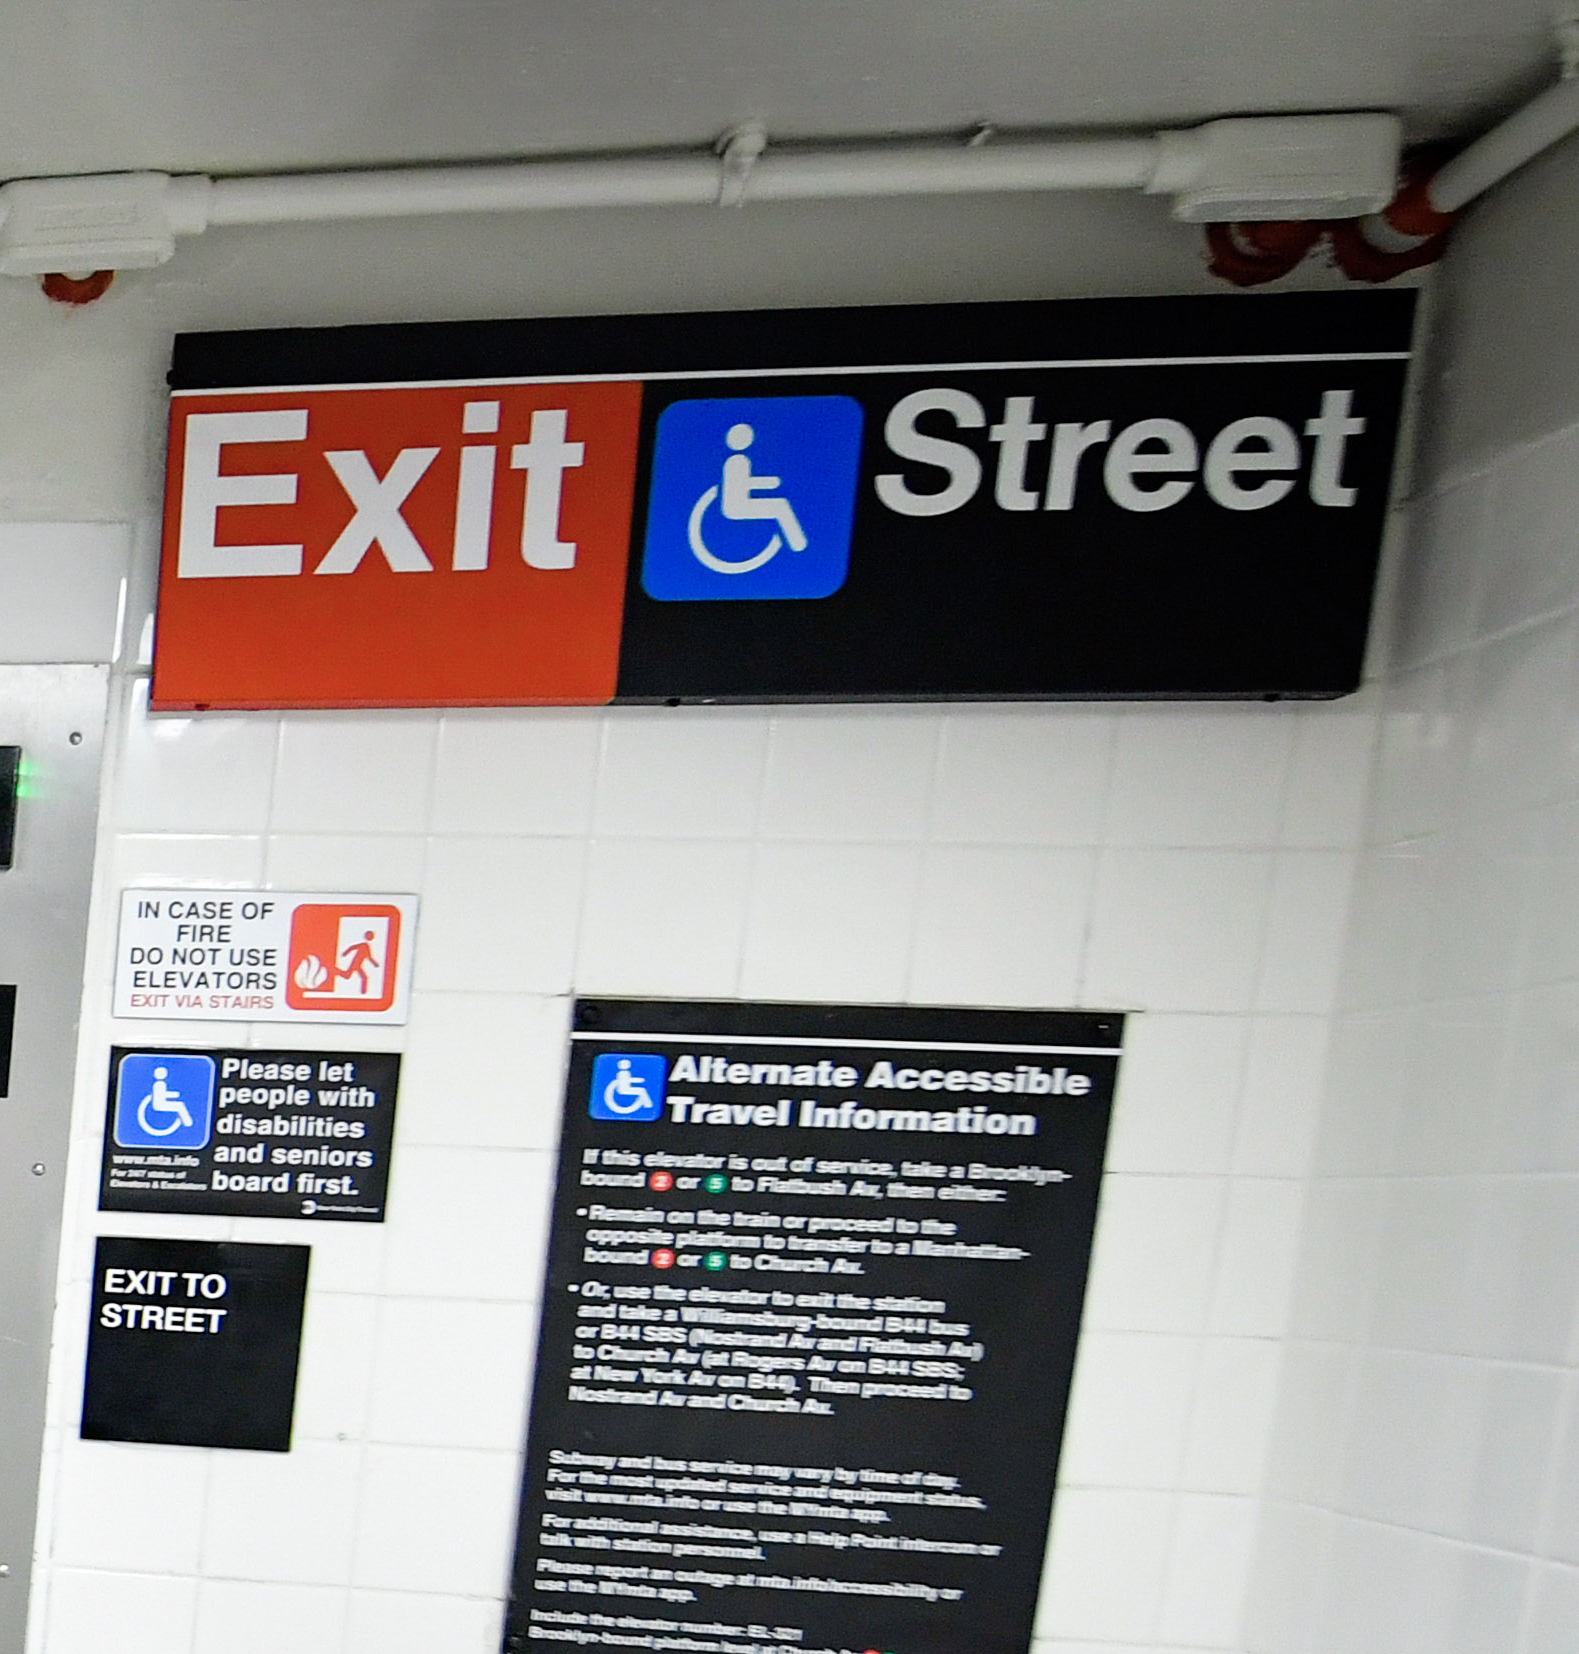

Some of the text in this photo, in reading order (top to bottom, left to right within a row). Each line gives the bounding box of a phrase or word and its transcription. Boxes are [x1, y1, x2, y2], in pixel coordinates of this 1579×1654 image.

[177, 387, 1366, 579] Exit Street
[138, 901, 275, 920] IN CASE OF
[176, 924, 232, 943] FIRE
[130, 947, 277, 967] DO NOT USE
[133, 971, 277, 990] ELEVATORS
[130, 994, 275, 1010] EXIT VIA STAIRS
[221, 1057, 355, 1083] Please let
[668, 1055, 1091, 1095] Alternate Accessible
[218, 1085, 376, 1110] people with
[216, 1113, 366, 1139] disabilities
[666, 1095, 1035, 1135] Travel Information
[213, 1142, 374, 1168] and seniors
[582, 1148, 1072, 1186] If this elevator is out of service, take a Brooklyn-
[211, 1170, 290, 1194] board
[296, 1172, 359, 1196] first.
[580, 1169, 646, 1187] bound
[676, 1176, 701, 1189] or
[731, 1176, 754, 1191] to
[756, 1176, 846, 1195] Flatbush
[848, 1180, 883, 1198] Av,
[886, 1182, 935, 1198] then
[588, 1204, 956, 1235] Remain on the train or proceed to the
[585, 1228, 674, 1245] opposite
[675, 1230, 761, 1248] platform
[762, 1234, 786, 1249] to
[787, 1235, 869, 1253] transfer
[869, 1239, 894, 1254] to
[894, 1242, 910, 1255] a
[583, 1246, 649, 1264] bound
[676, 1254, 702, 1266] or
[729, 1254, 752, 1269] to
[753, 1254, 829, 1272] Church
[830, 1258, 865, 1274] Av.
[104, 1268, 228, 1299] EXIT TO
[581, 1281, 945, 1313] Or, use the elevator to exit the station
[99, 1303, 227, 1334] STREET
[576, 1303, 617, 1318] and
[618, 1304, 662, 1321] take
[662, 1309, 678, 1321] a
[884, 1316, 926, 1333] B44
[927, 1318, 969, 1336] bus
[575, 1325, 600, 1338] or
[600, 1323, 640, 1340] B44
[641, 1325, 687, 1343] SBS
[786, 1333, 817, 1349] Av
[816, 1336, 858, 1351] and
[857, 1336, 946, 1356] Flatbush
[573, 1344, 595, 1359] to
[596, 1344, 670, 1362] Church
[671, 1348, 700, 1364] Av
[701, 1350, 730, 1369] (at
[730, 1351, 805, 1372] Rogers
[805, 1355, 836, 1371] Av
[837, 1360, 866, 1373] on
[867, 1358, 910, 1375] B44
[569, 1365, 592, 1379] at
[593, 1365, 638, 1382] New
[640, 1367, 686, 1384] York
[686, 1370, 717, 1386] Av
[717, 1375, 746, 1387] on
[807, 1376, 860, 1394] Then
[861, 1382, 949, 1399] proceed
[948, 1385, 972, 1400] to
[568, 1385, 834, 1414] Nostrand Av and Church Av.
